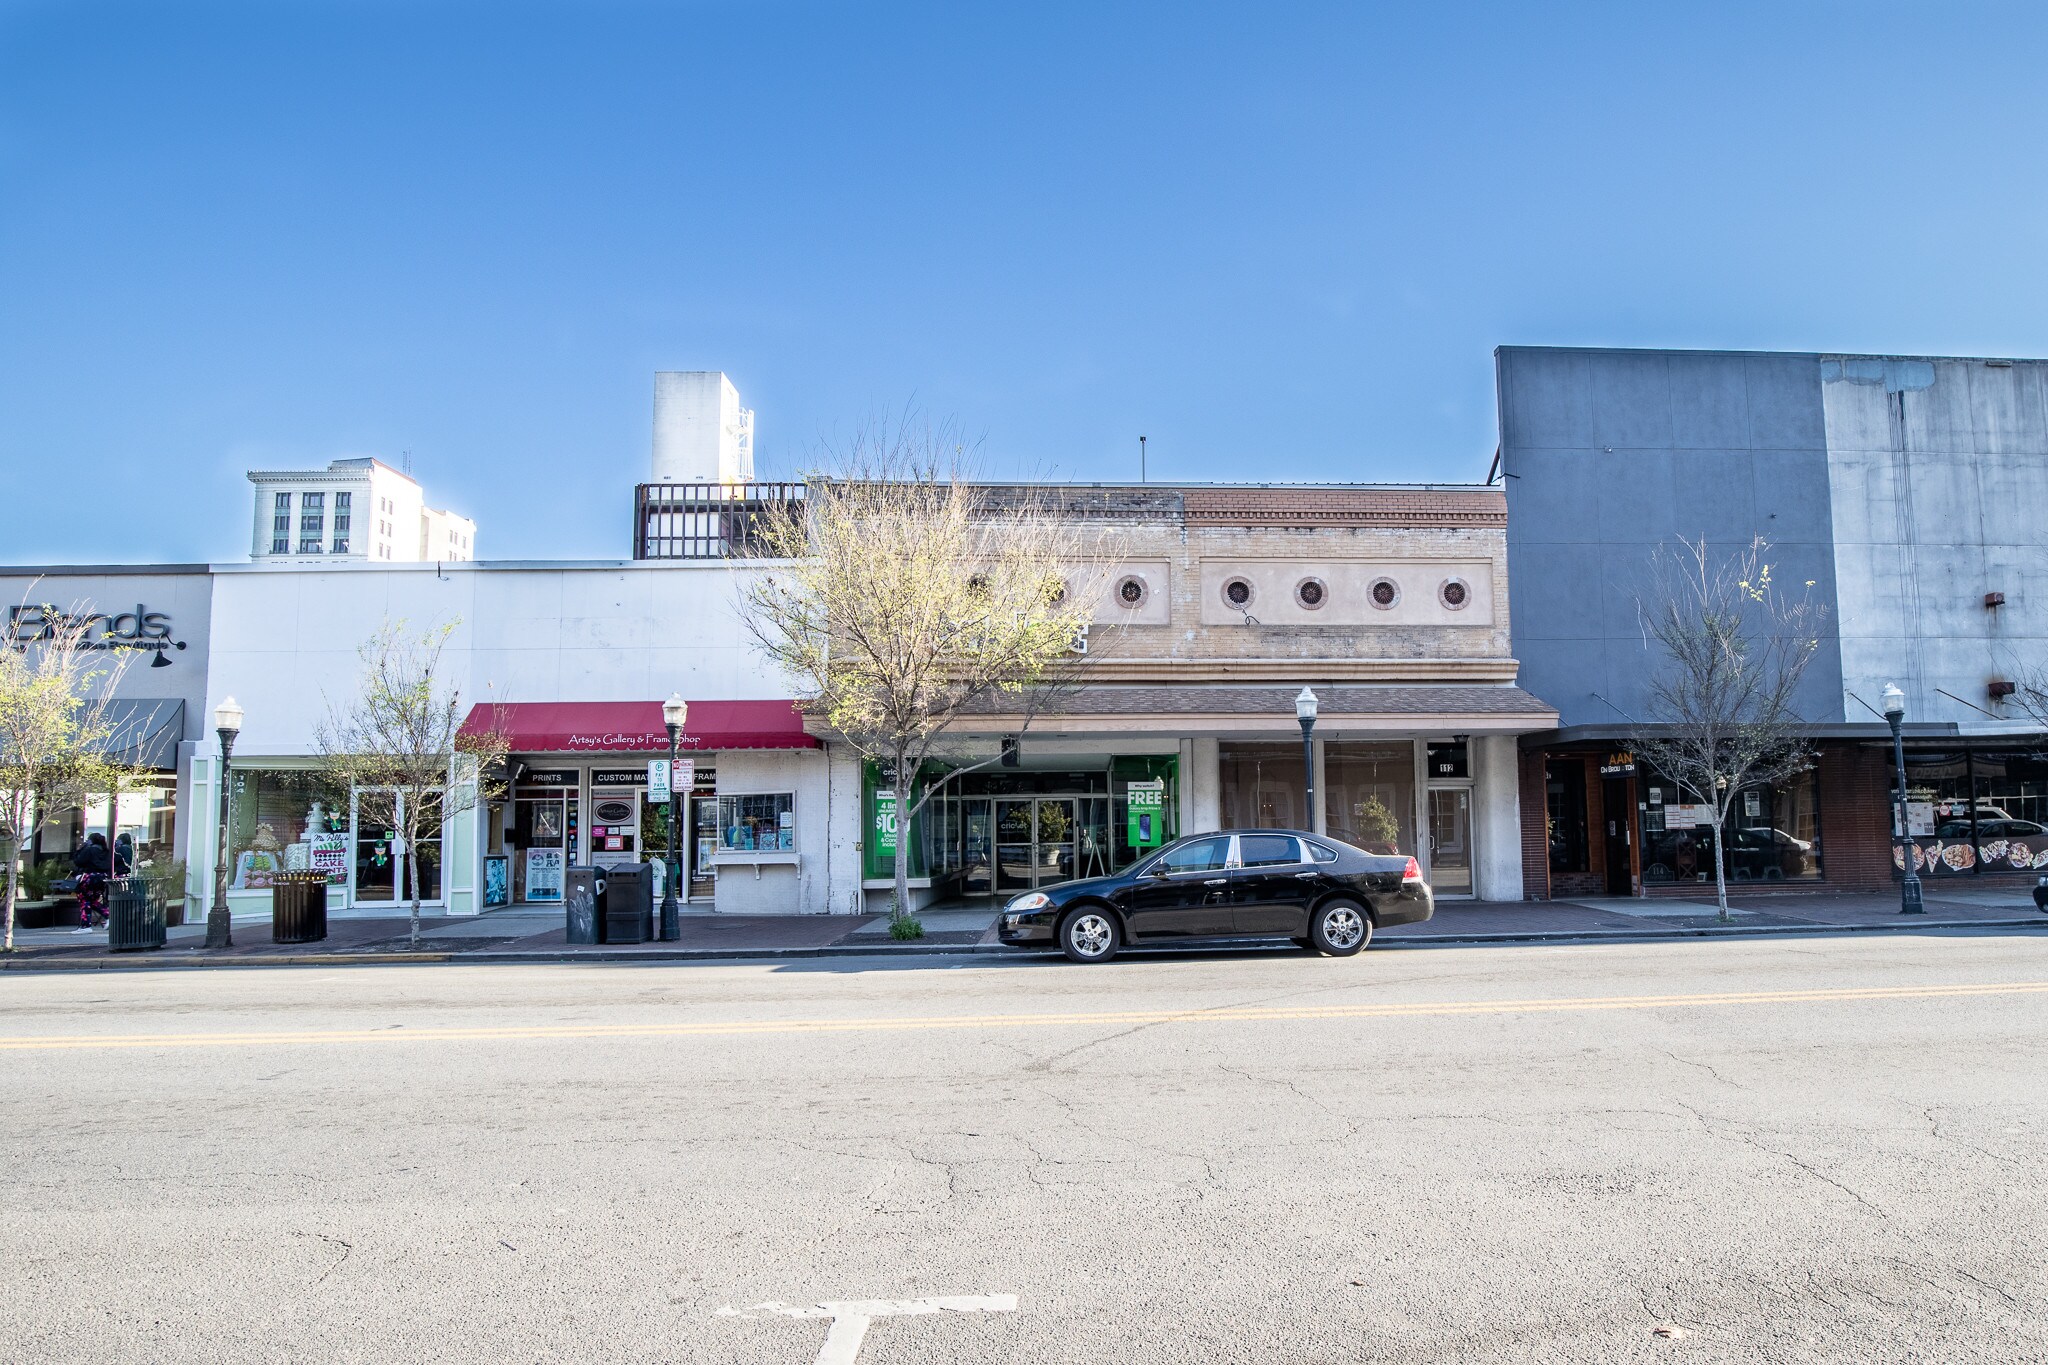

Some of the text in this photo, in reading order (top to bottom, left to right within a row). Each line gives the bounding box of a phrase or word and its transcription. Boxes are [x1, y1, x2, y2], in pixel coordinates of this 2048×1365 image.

[568, 734, 601, 747] Artsy's
[603, 733, 636, 747] Gallery
[637, 736, 644, 744] &
[532, 774, 562, 782] PRINTS
[598, 774, 648, 782] CUSTOM MA
[1128, 791, 1162, 804] FREE
